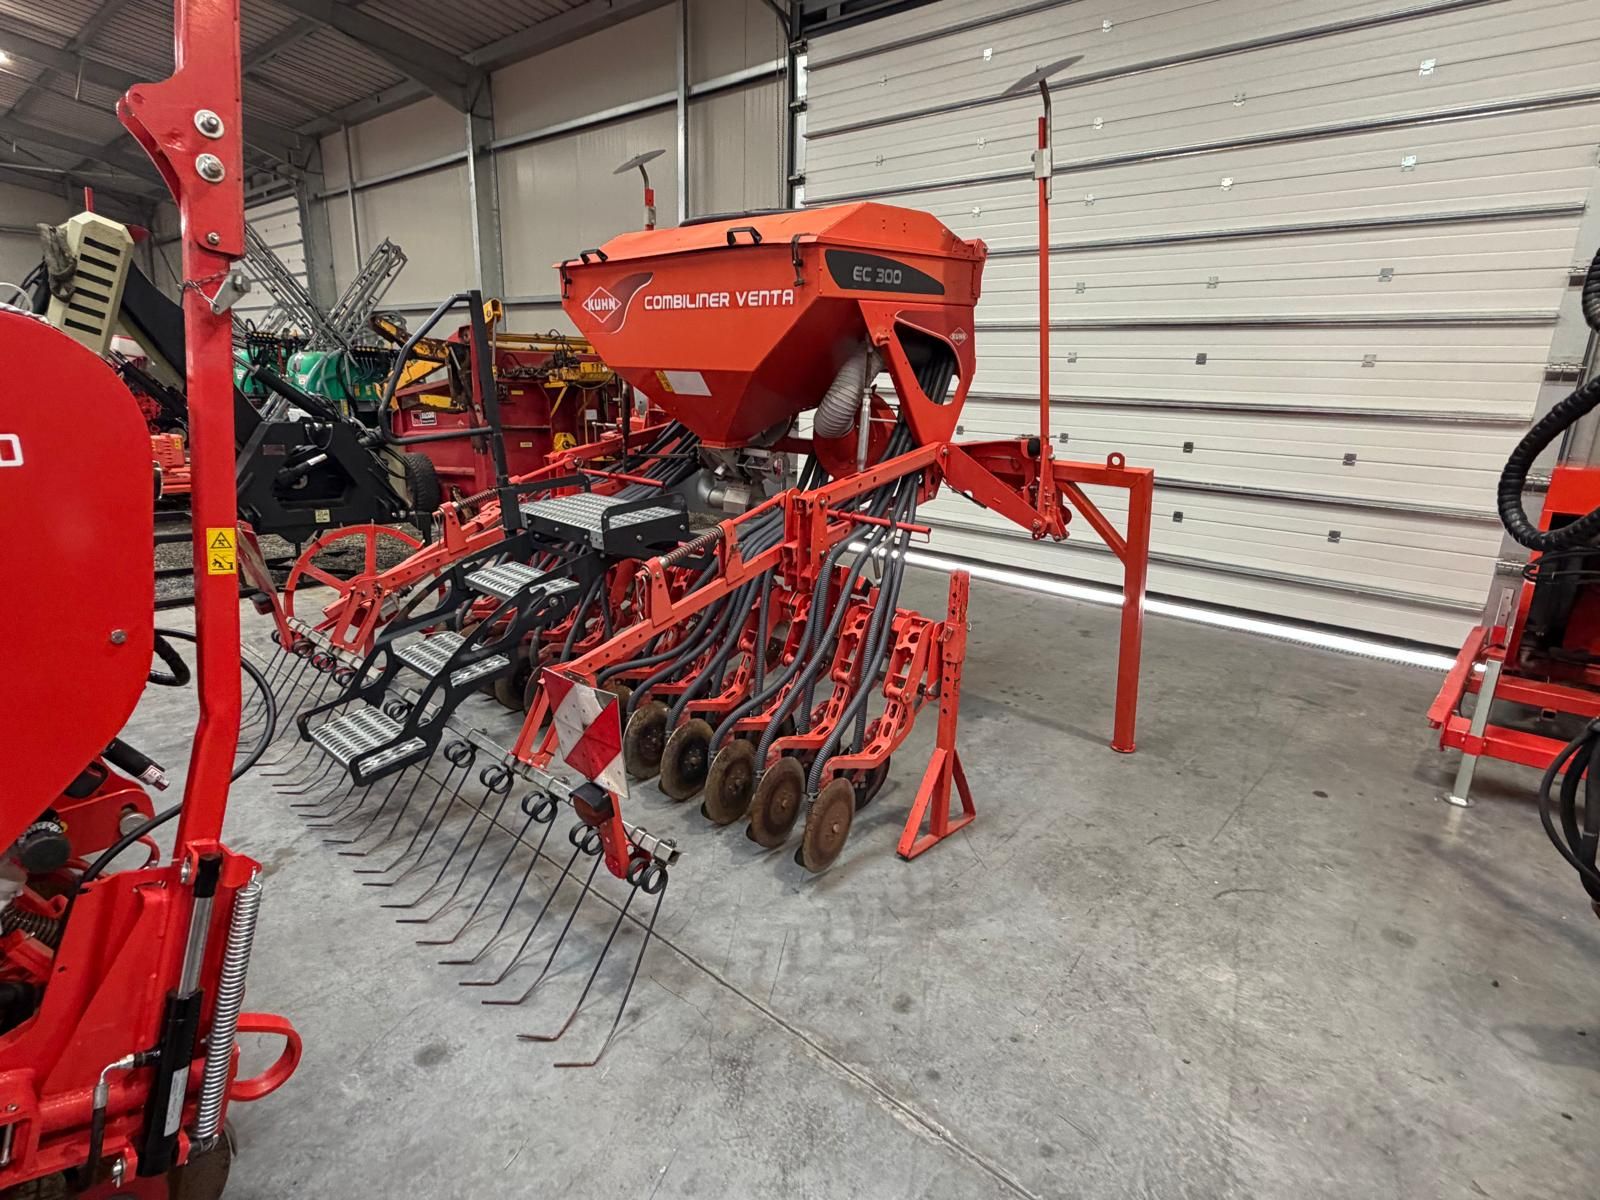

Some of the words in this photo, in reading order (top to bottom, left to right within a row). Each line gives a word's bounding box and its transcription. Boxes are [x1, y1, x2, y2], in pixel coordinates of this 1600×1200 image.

[853, 266, 872, 282] EC
[876, 268, 902, 284] 300
[587, 297, 616, 311] KUHN
[644, 292, 730, 310] COMBILINER
[736, 289, 794, 307] VENTA
